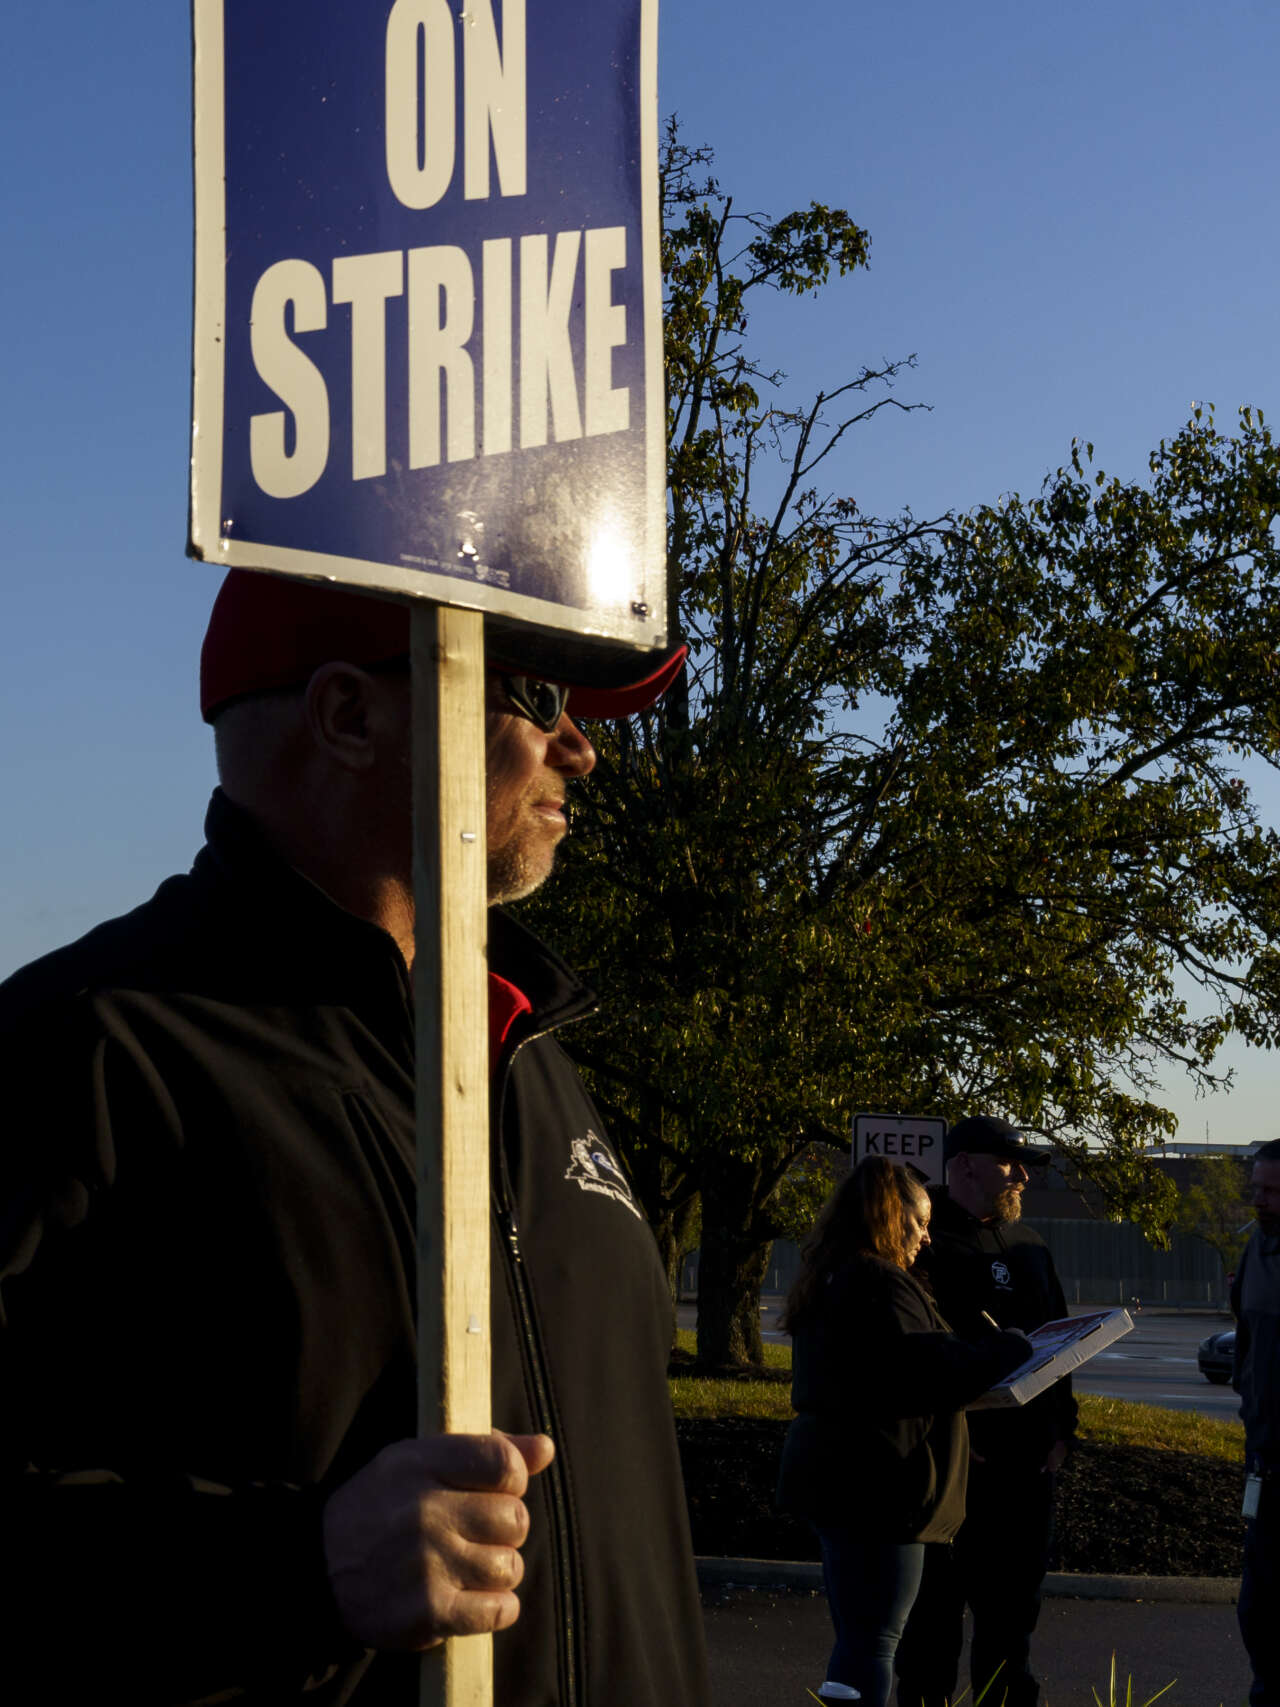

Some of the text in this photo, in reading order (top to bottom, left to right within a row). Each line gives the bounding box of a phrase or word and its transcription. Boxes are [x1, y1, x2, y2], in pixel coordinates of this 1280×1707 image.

[385, 0, 527, 210] ON
[250, 226, 630, 499] STRIKE
[865, 1131, 934, 1156] KEEP
